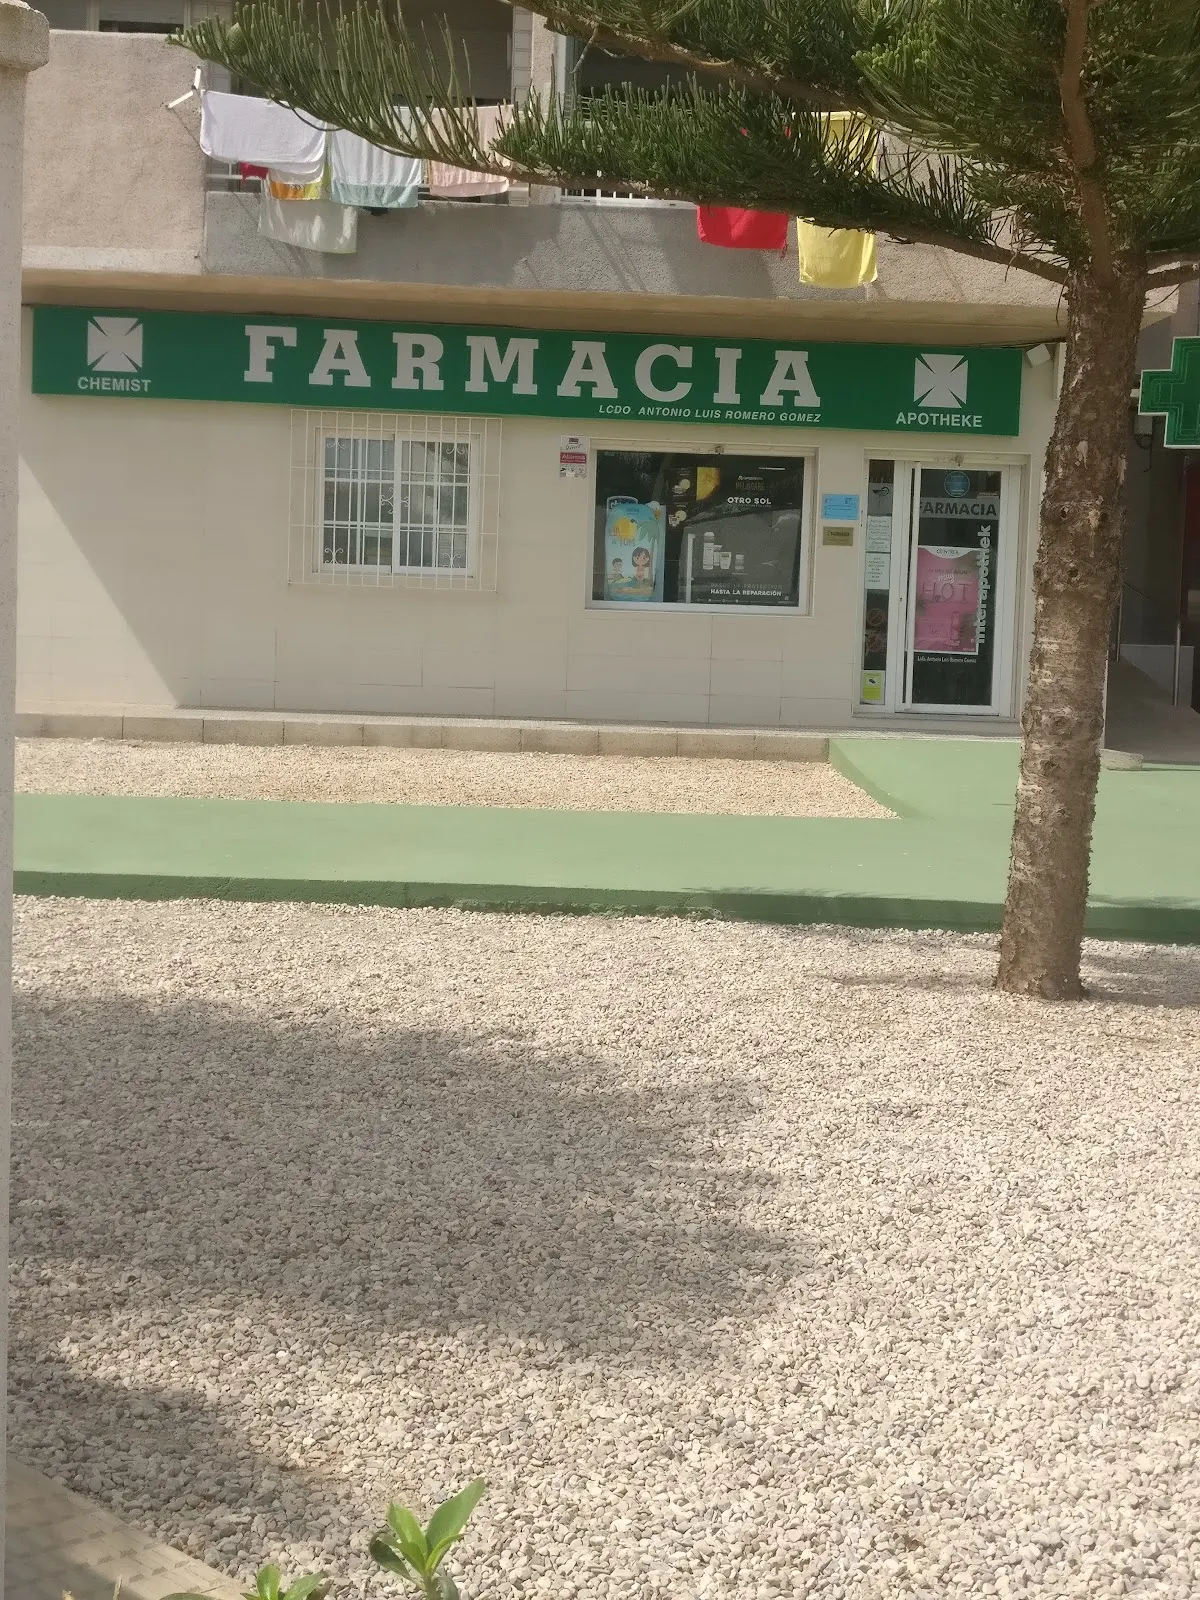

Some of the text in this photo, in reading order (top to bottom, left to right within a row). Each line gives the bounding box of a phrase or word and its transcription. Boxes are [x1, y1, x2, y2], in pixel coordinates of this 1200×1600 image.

[243, 324, 821, 408] FARMACIA
[77, 376, 151, 392] CHEMIST
[638, 406, 692, 418] ANTONIO
[694, 408, 722, 419] LUIS
[725, 410, 776, 421] ROMERO
[779, 412, 822, 423] GOMEZ
[895, 411, 982, 429] APOTHEKE
[727, 496, 752, 505] OTRO
[753, 497, 772, 506] SOL
[971, 524, 991, 644] interapothek
[710, 588, 731, 596] HASTA
[743, 589, 782, 598] REPARACIÓN
